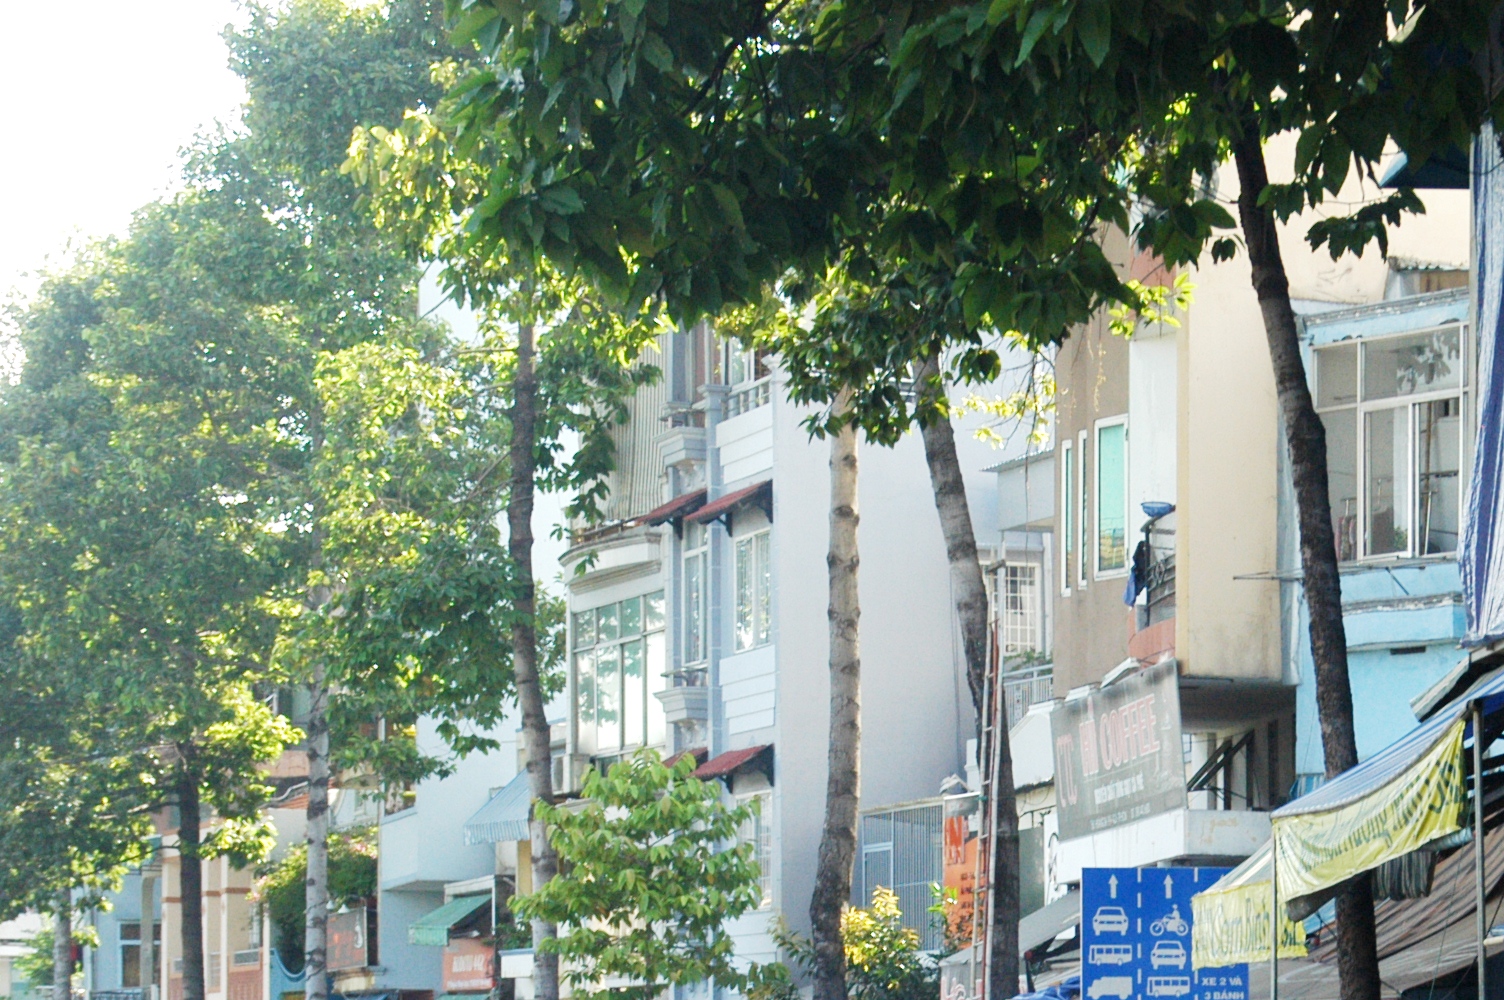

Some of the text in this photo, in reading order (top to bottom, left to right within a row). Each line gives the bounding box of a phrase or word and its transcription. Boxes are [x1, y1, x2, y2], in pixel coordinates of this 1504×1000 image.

[1101, 693, 1161, 771] COFFEE
[1201, 974, 1243, 987] XE 2 VÀ
[1204, 988, 1245, 1000] 3 BÁNH
